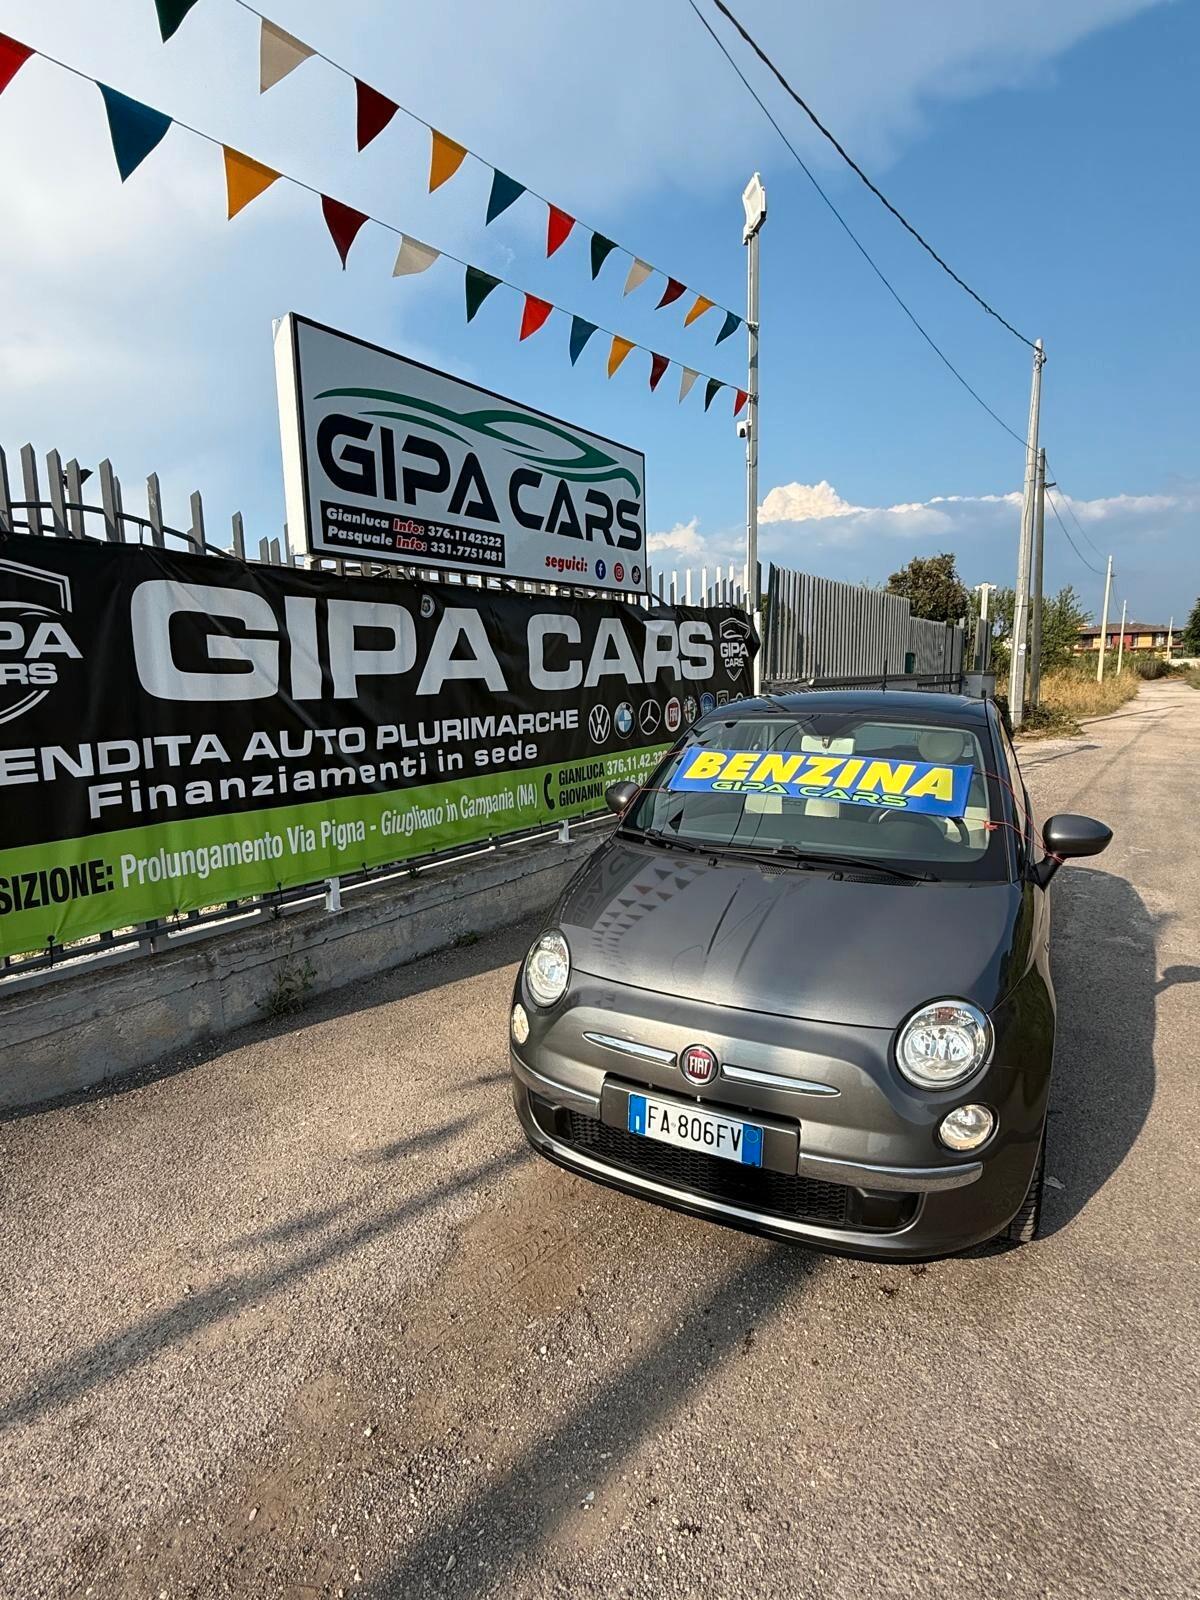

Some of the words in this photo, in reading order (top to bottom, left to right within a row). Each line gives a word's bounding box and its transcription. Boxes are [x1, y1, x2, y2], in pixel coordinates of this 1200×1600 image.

[316, 413, 501, 523] GIPA
[508, 467, 642, 552] CARS
[326, 507, 389, 529] Gianluca
[393, 517, 425, 535] Info:
[427, 525, 502, 547] 376.1142322
[327, 525, 393, 546] Pasquale
[395, 535, 428, 551] Info:
[430, 541, 503, 562] 331.7751481
[544, 555, 588, 573] seguici:
[131, 579, 509, 701] GIPA
[527, 613, 715, 691] CARS
[720, 642, 749, 658] GIPA
[724, 658, 744, 668] CARS
[243, 726, 366, 761] AUTO
[376, 708, 579, 750] PLURIMARCHE
[88, 752, 427, 819] Finanziamenti
[438, 750, 464, 772] in
[474, 740, 538, 766] sede
[558, 762, 605, 786] GIANLUCA
[682, 751, 954, 802] BENZINA
[559, 782, 603, 807] GIOVANNI
[711, 780, 790, 794] GIPA
[799, 786, 909, 808] CARS
[120, 832, 283, 888] Prolungamento
[287, 824, 317, 855] Via
[320, 819, 366, 851] Pigna
[381, 804, 443, 837] Giugliano
[446, 799, 458, 820] in
[460, 787, 515, 818] Campania
[516, 783, 538, 811] (NA)
[689, 1056, 710, 1075] FIAT
